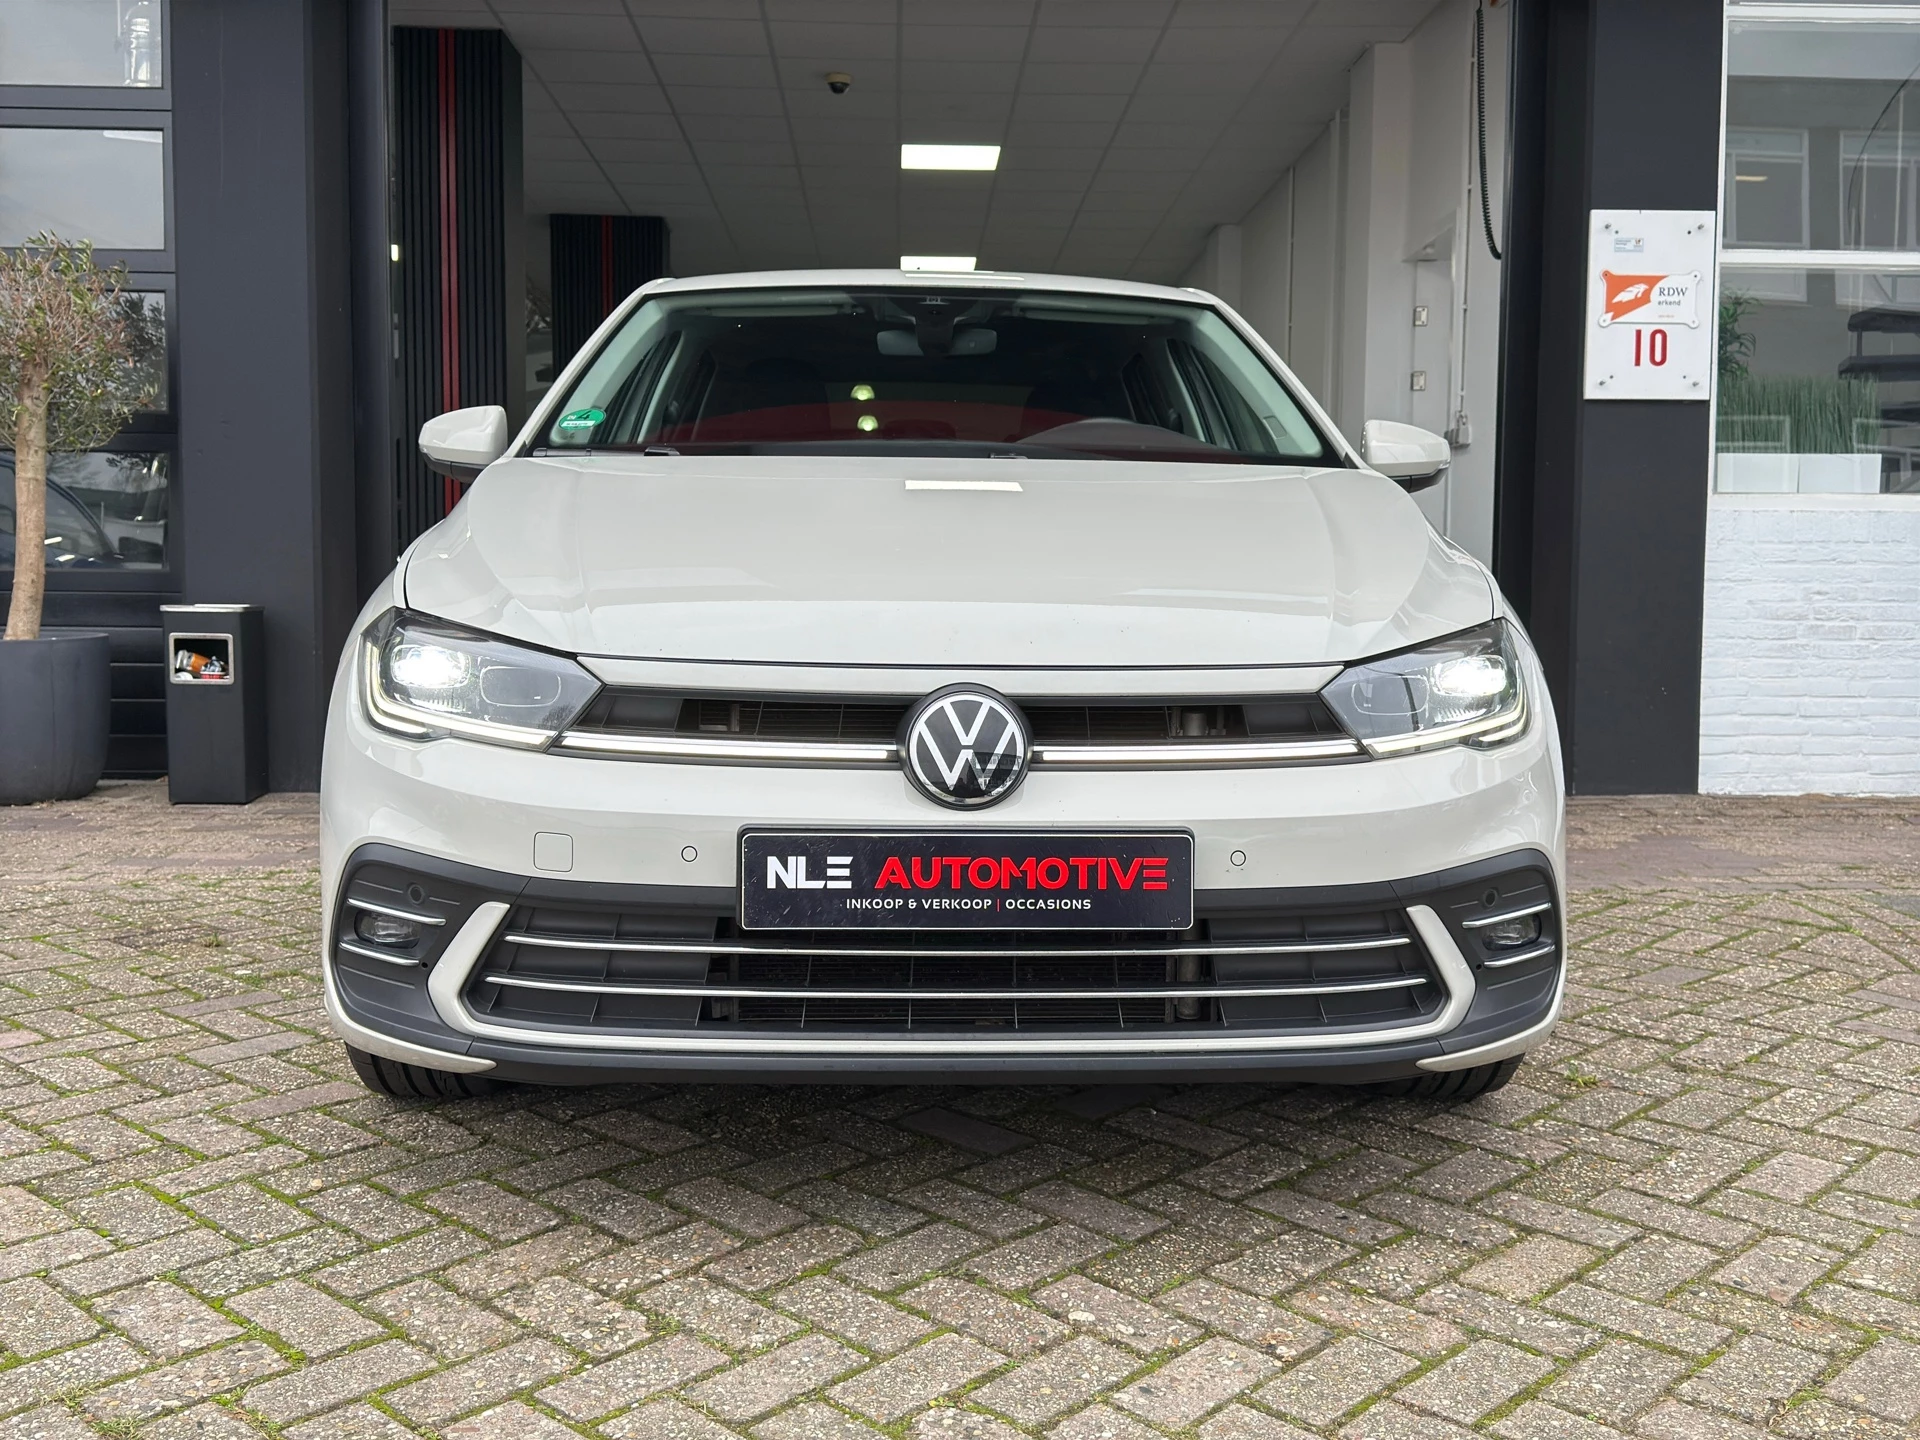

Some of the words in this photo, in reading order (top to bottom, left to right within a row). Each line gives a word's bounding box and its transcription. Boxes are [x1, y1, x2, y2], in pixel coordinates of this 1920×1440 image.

[1658, 286, 1688, 297] RDW
[1634, 328, 1668, 367] 10
[766, 855, 854, 889] NLE
[874, 856, 1169, 891] AUTOMOTIVE
[846, 898, 904, 910] INKOOP
[908, 898, 918, 910] &
[921, 898, 992, 910] VERKOOP
[1005, 899, 1092, 910] OCCASIONS
